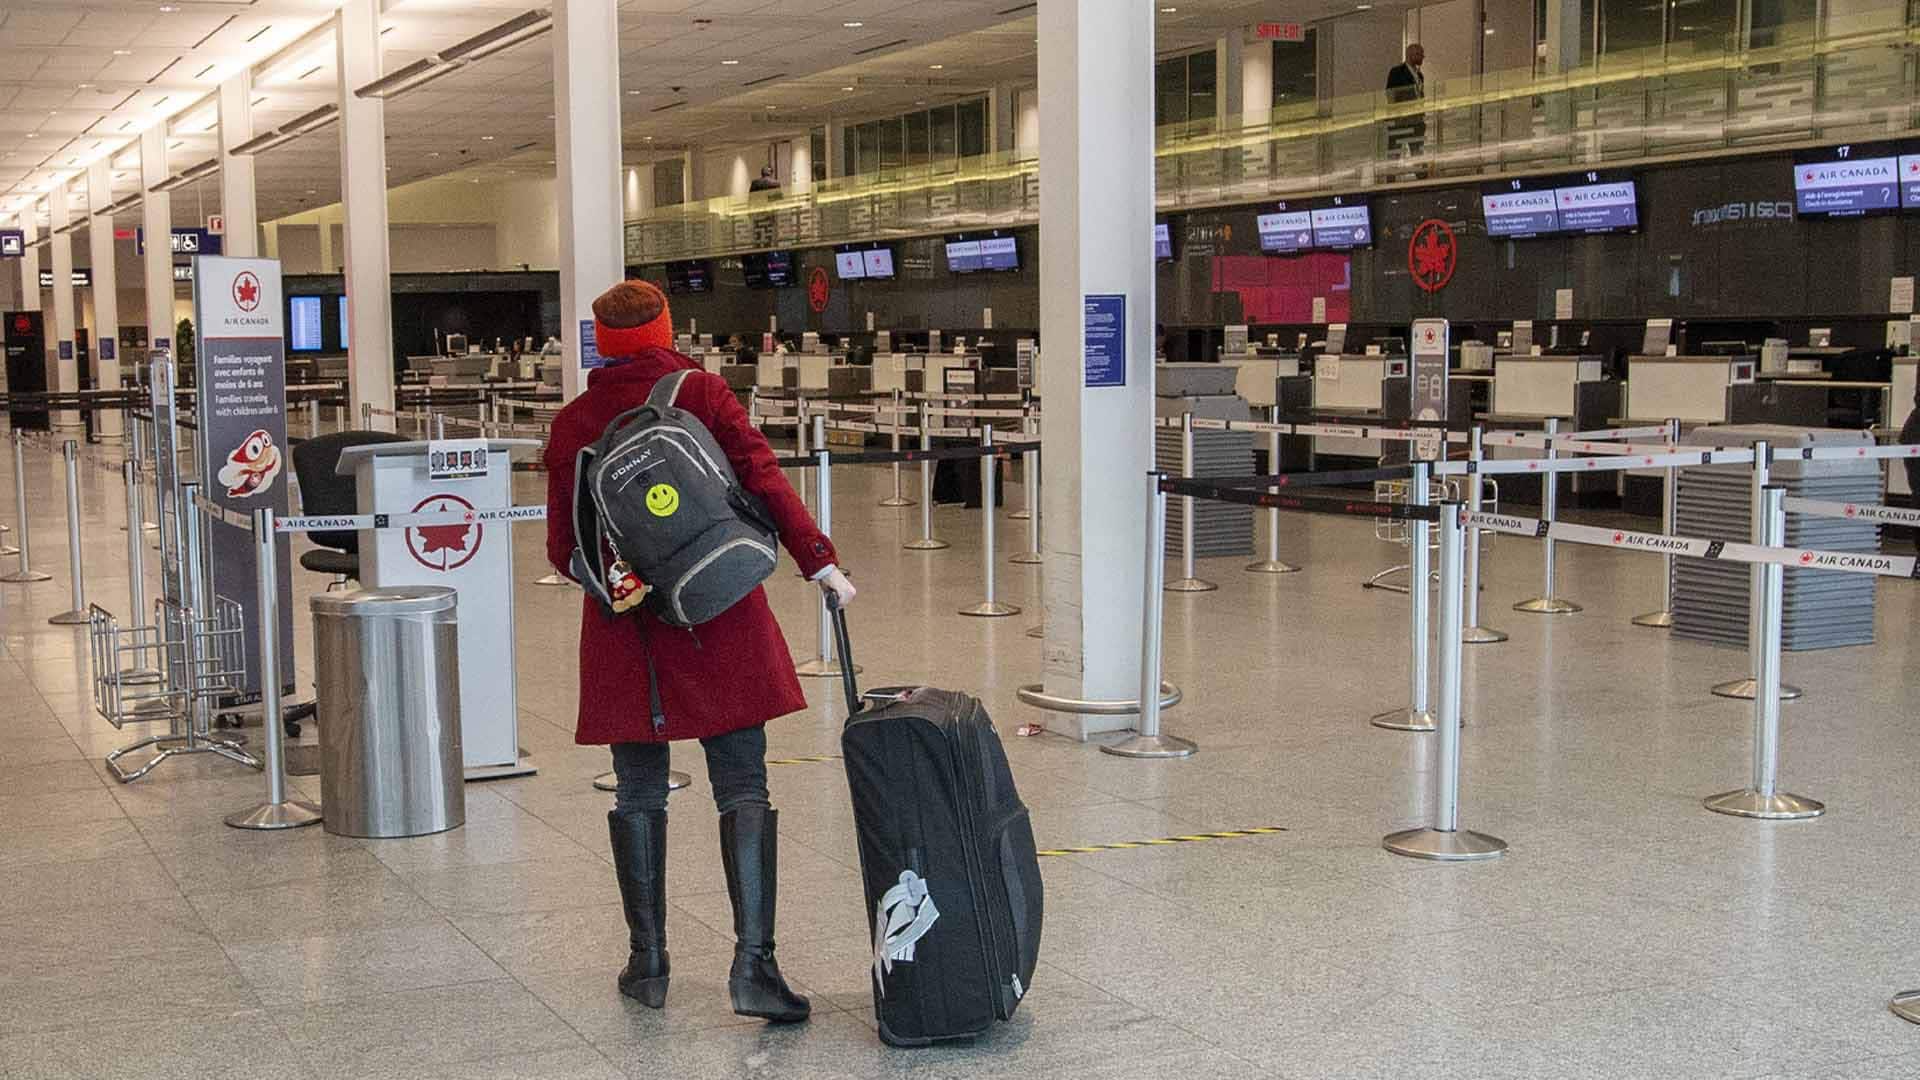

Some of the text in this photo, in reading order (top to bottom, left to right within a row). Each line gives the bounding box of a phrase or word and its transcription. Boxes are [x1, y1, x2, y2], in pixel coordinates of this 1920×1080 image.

[1837, 145, 1850, 158] 17
[1819, 167, 1889, 180] AIR CANADA
[1590, 190, 1628, 200] CANADA
[214, 354, 242, 364] Families
[214, 369, 231, 377] avec
[231, 366, 257, 376] enfants
[214, 380, 237, 389] moins
[238, 380, 246, 388] de
[215, 394, 242, 403] Families
[215, 407, 232, 416] with
[232, 406, 258, 416] children
[611, 448, 652, 481] DONNAY
[479, 508, 543, 520] AIR CANADA
[1858, 508, 1877, 517] AIR
[286, 519, 355, 527] AIR CANADA
[1469, 514, 1522, 529] AIR CANADA
[1625, 536, 1690, 551] AIR CANADA
[1815, 555, 1891, 569] AIR CANADA
